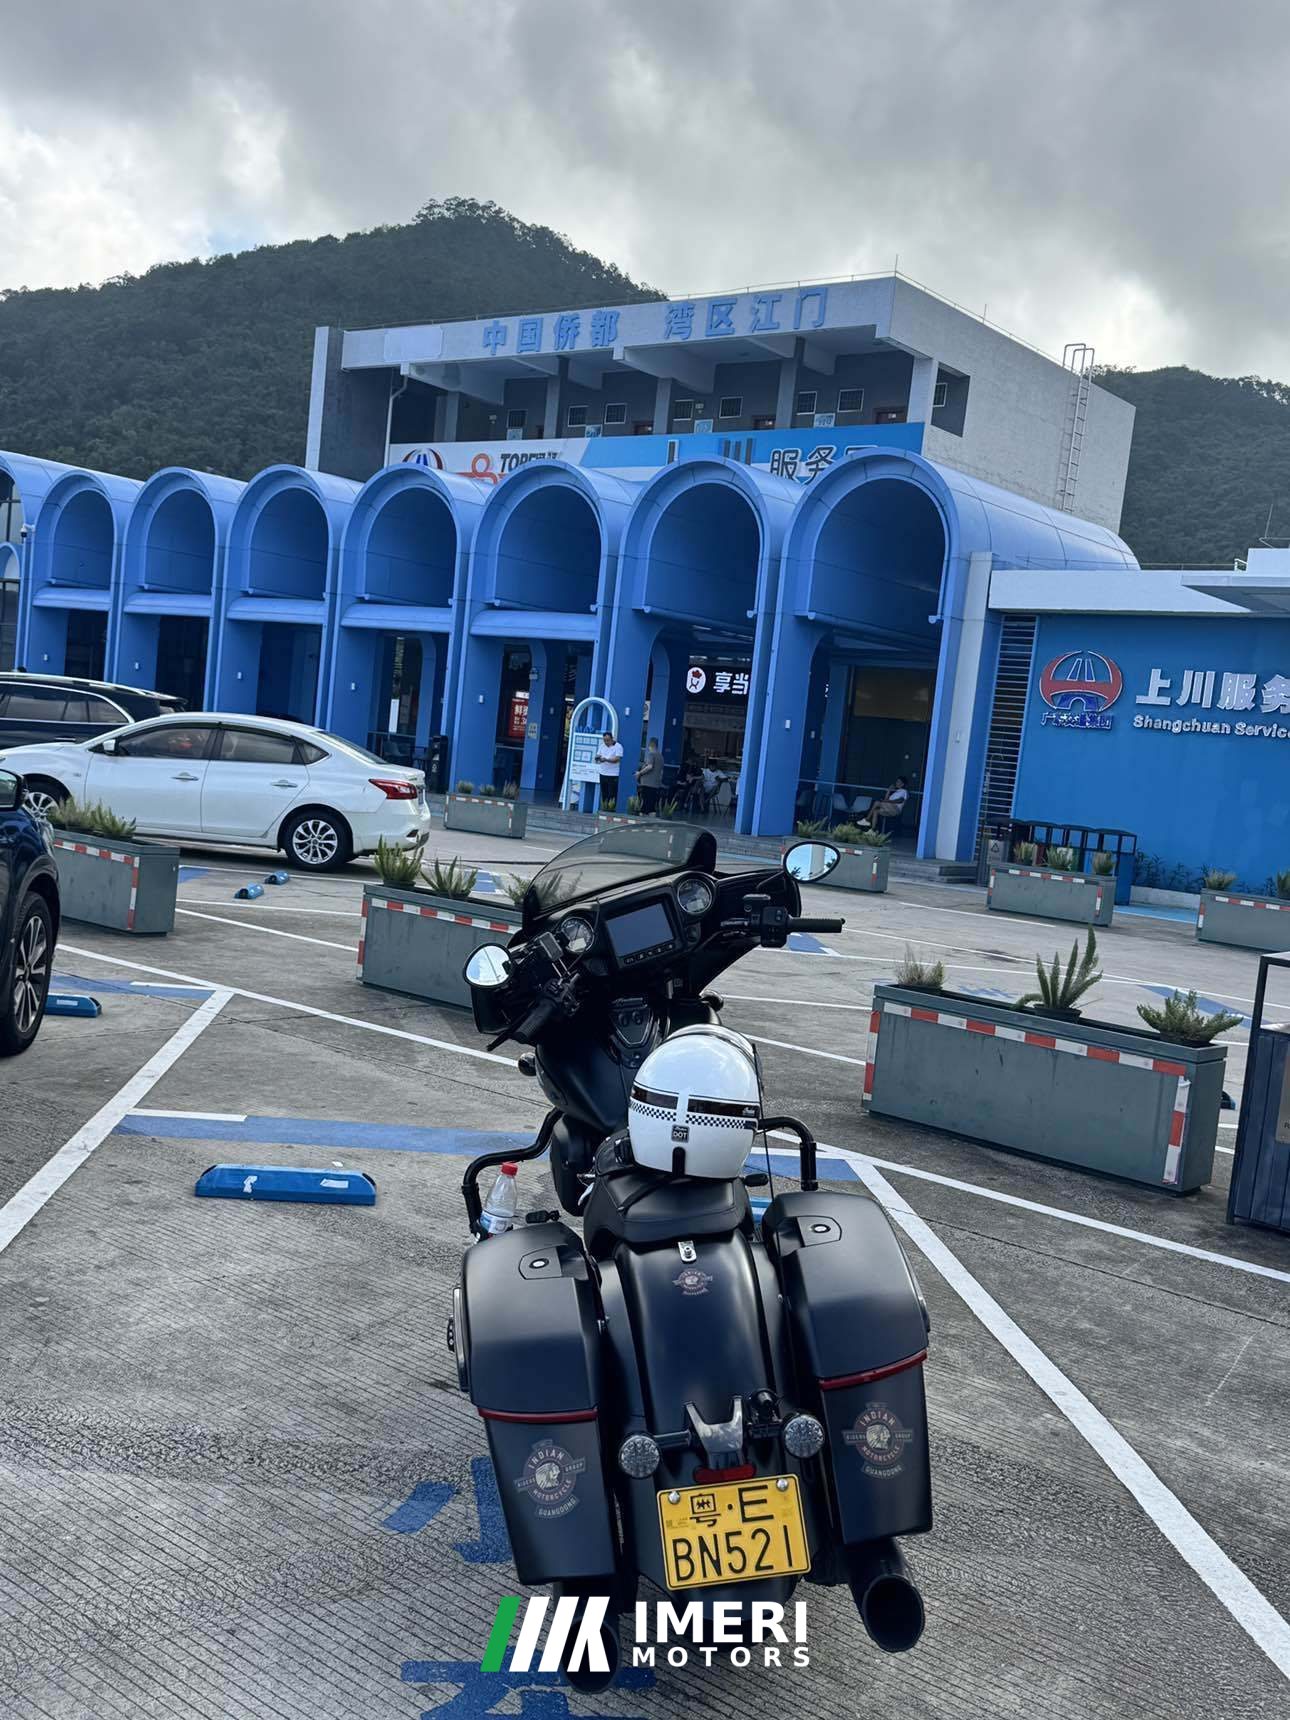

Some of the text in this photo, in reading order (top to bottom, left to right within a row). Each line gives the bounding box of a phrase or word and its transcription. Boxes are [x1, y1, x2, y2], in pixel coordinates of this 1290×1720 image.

[482, 287, 828, 355] 中国侨都 湾区江门
[1135, 668, 1290, 715] 上川服务
[1133, 713, 1231, 735] Shangchuan
[860, 1411, 896, 1427] INDIAN
[528, 1449, 565, 1470] INDIAN
[532, 1479, 572, 1501] MOTORCYCLE
[672, 1525, 793, 1581] BN521
